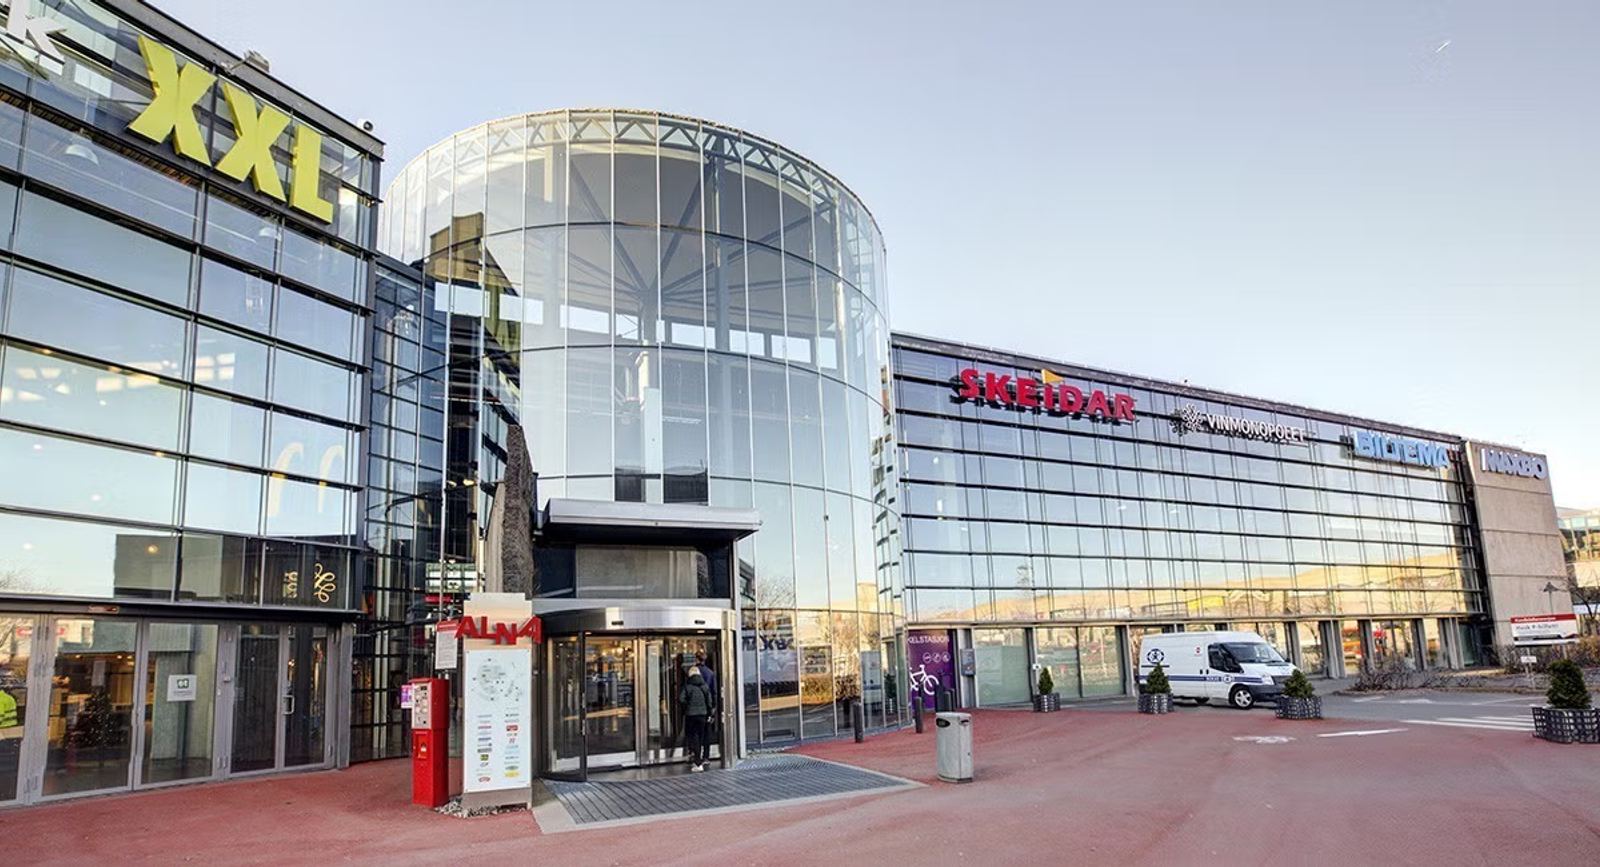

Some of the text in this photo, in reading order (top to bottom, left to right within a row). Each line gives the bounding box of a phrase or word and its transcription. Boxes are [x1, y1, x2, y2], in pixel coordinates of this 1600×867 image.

[128, 34, 333, 224] XXL
[1206, 413, 1307, 442] VINMONOPOLET
[1353, 430, 1449, 469] BILTEMA
[1480, 448, 1549, 480] MAXBO
[455, 615, 542, 646] ALNA
